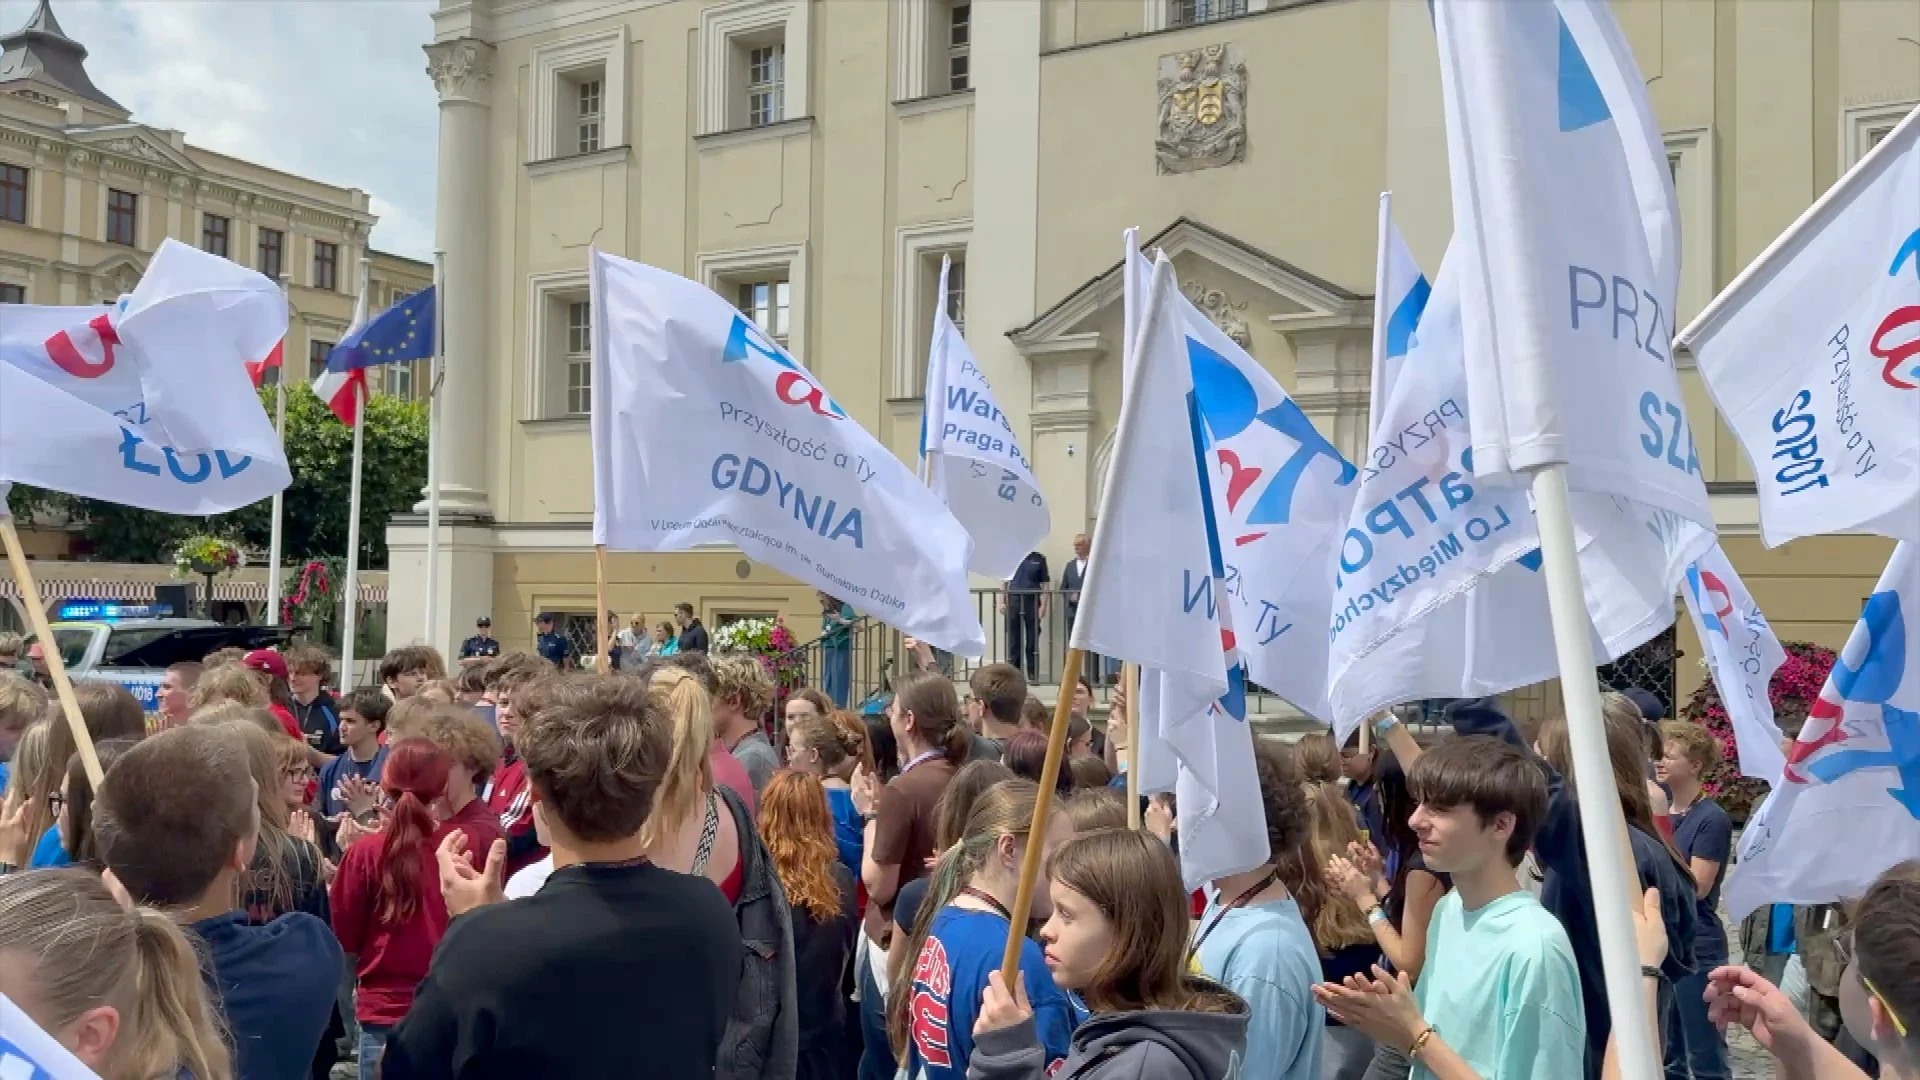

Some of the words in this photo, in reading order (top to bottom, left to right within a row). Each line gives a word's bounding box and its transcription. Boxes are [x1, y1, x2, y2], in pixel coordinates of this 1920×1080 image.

[1568, 264, 1673, 368] PRZ
[719, 401, 828, 461] Przyszłość
[833, 452, 848, 469] a
[942, 422, 1004, 453] Praga
[1771, 389, 1829, 497] SOPOT
[711, 453, 864, 549] GDYNIA
